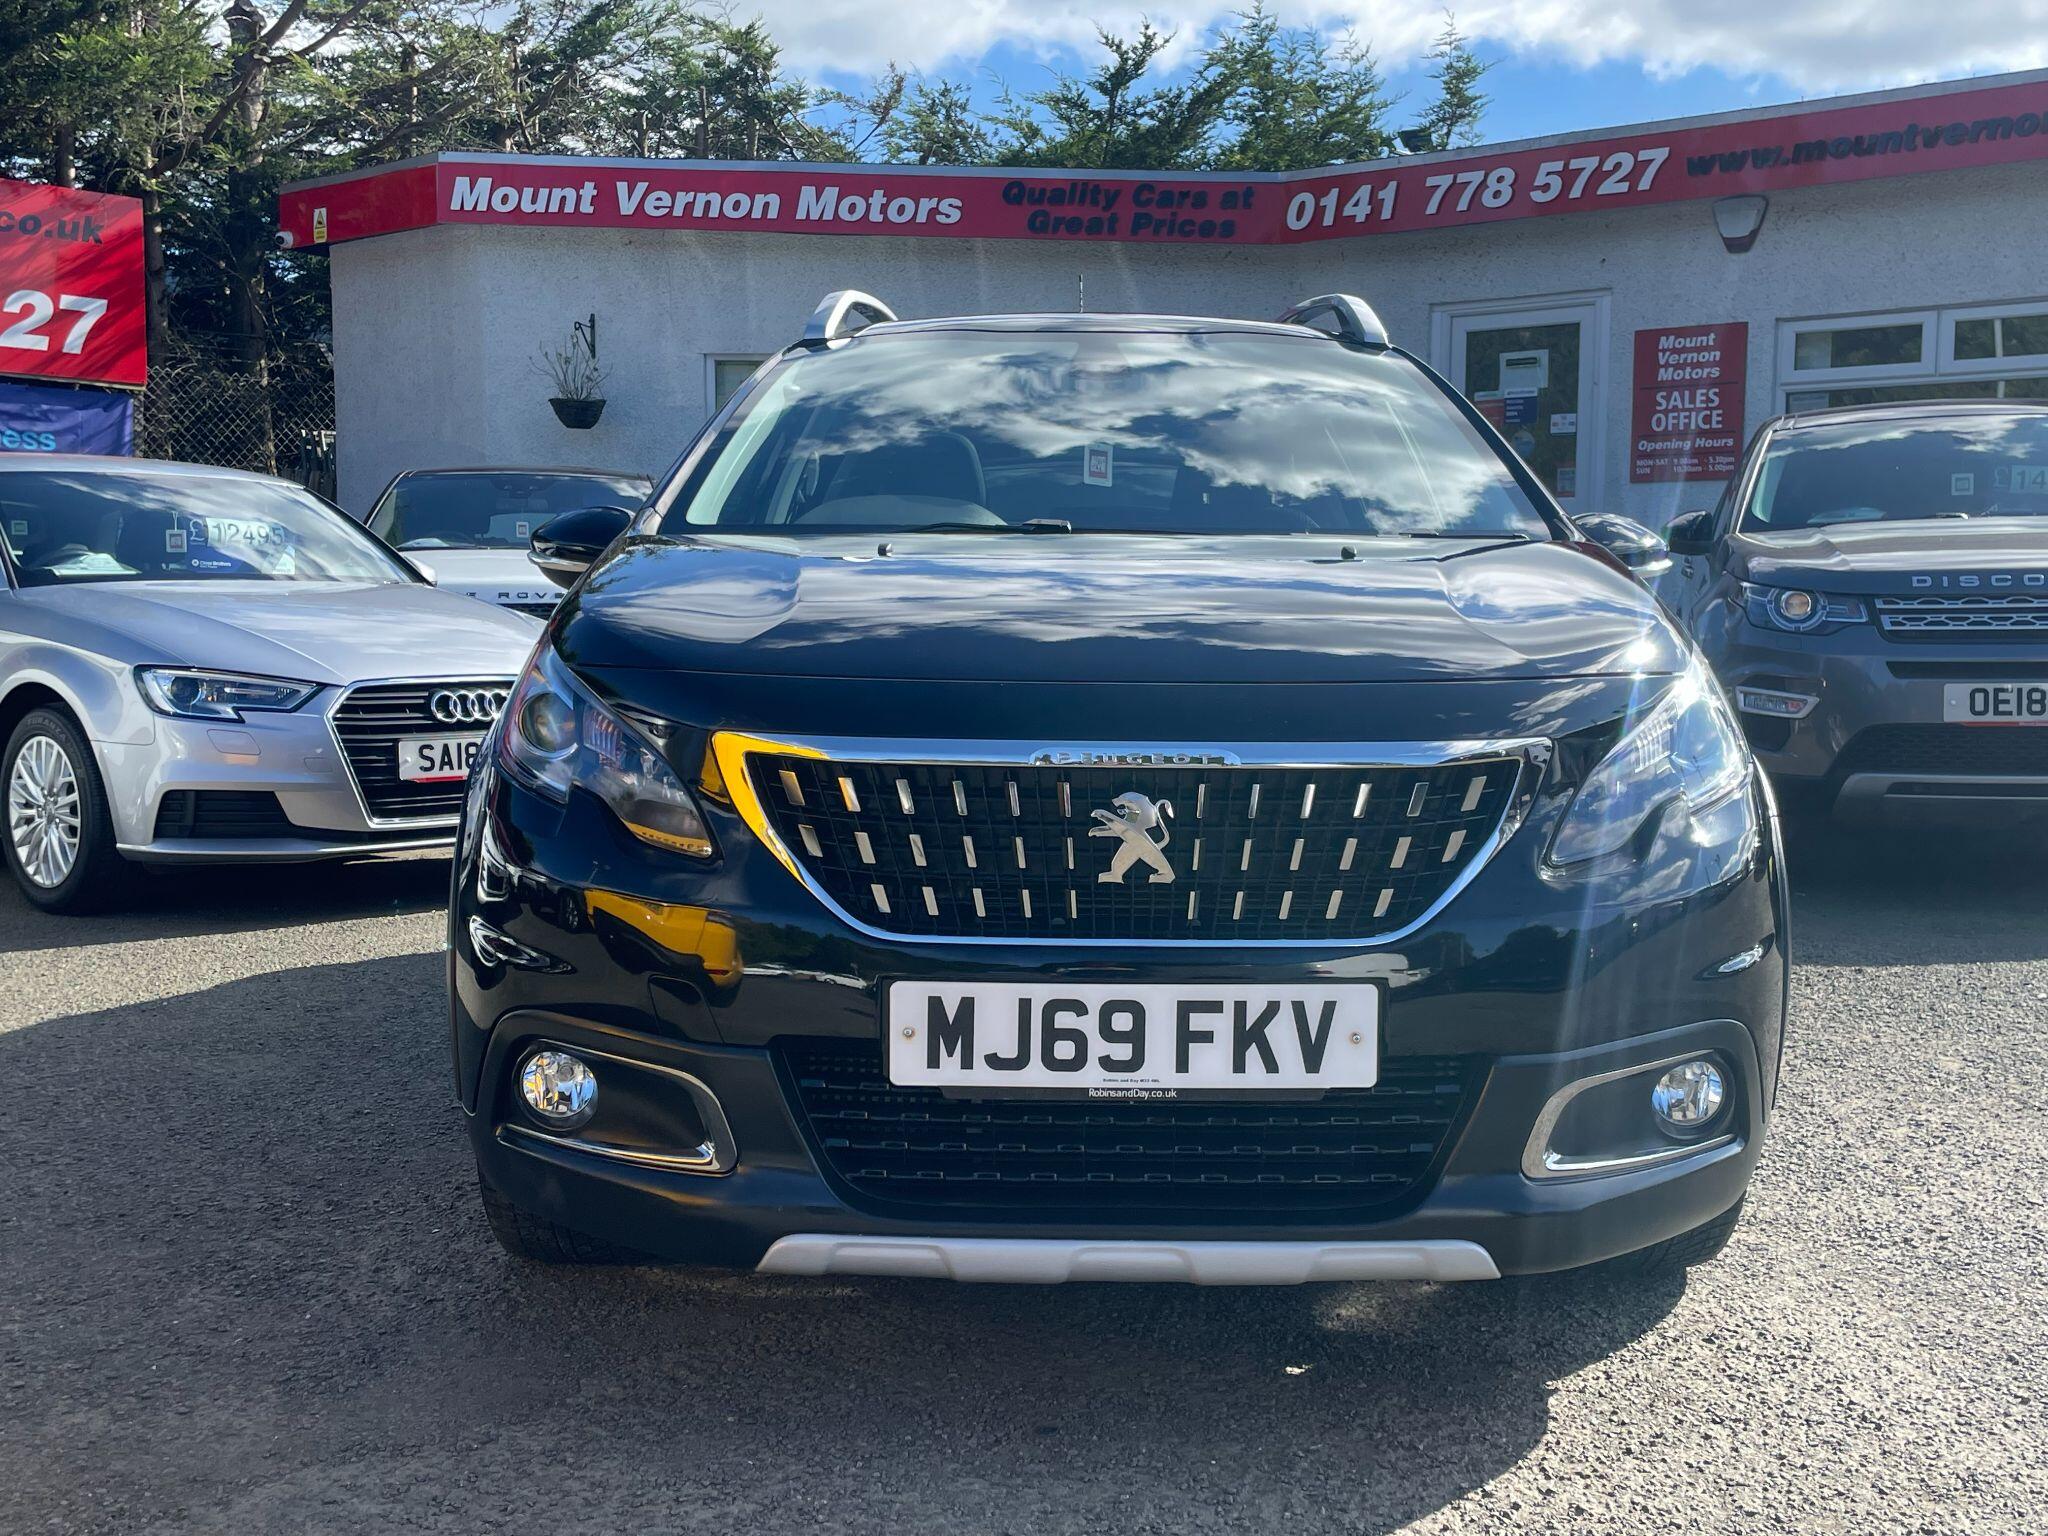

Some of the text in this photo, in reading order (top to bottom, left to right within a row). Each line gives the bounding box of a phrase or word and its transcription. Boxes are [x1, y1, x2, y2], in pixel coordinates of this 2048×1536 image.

[1686, 111, 2048, 177] www.mountverno
[450, 176, 963, 225] Mount Vernon Motors
[1002, 181, 1254, 211] Quality Cars at
[1286, 147, 1670, 232] 0141 778 5727
[1027, 209, 1237, 239] Great Prices
[0, 290, 108, 354] 27
[1658, 333, 1716, 350] Mount
[1658, 350, 1721, 365] Vernon
[1657, 366, 1721, 381] Motors
[1655, 388, 1720, 411] SALES
[1651, 410, 1723, 432] OFFICE
[0, 429, 57, 451] ess
[1638, 437, 1734, 452] Opening Hours
[1056, 751, 1213, 765] PEUGEOT
[925, 995, 1338, 1075] MJ69 FKV
[1088, 1088, 1177, 1099] RobinsandDay.co.uk
